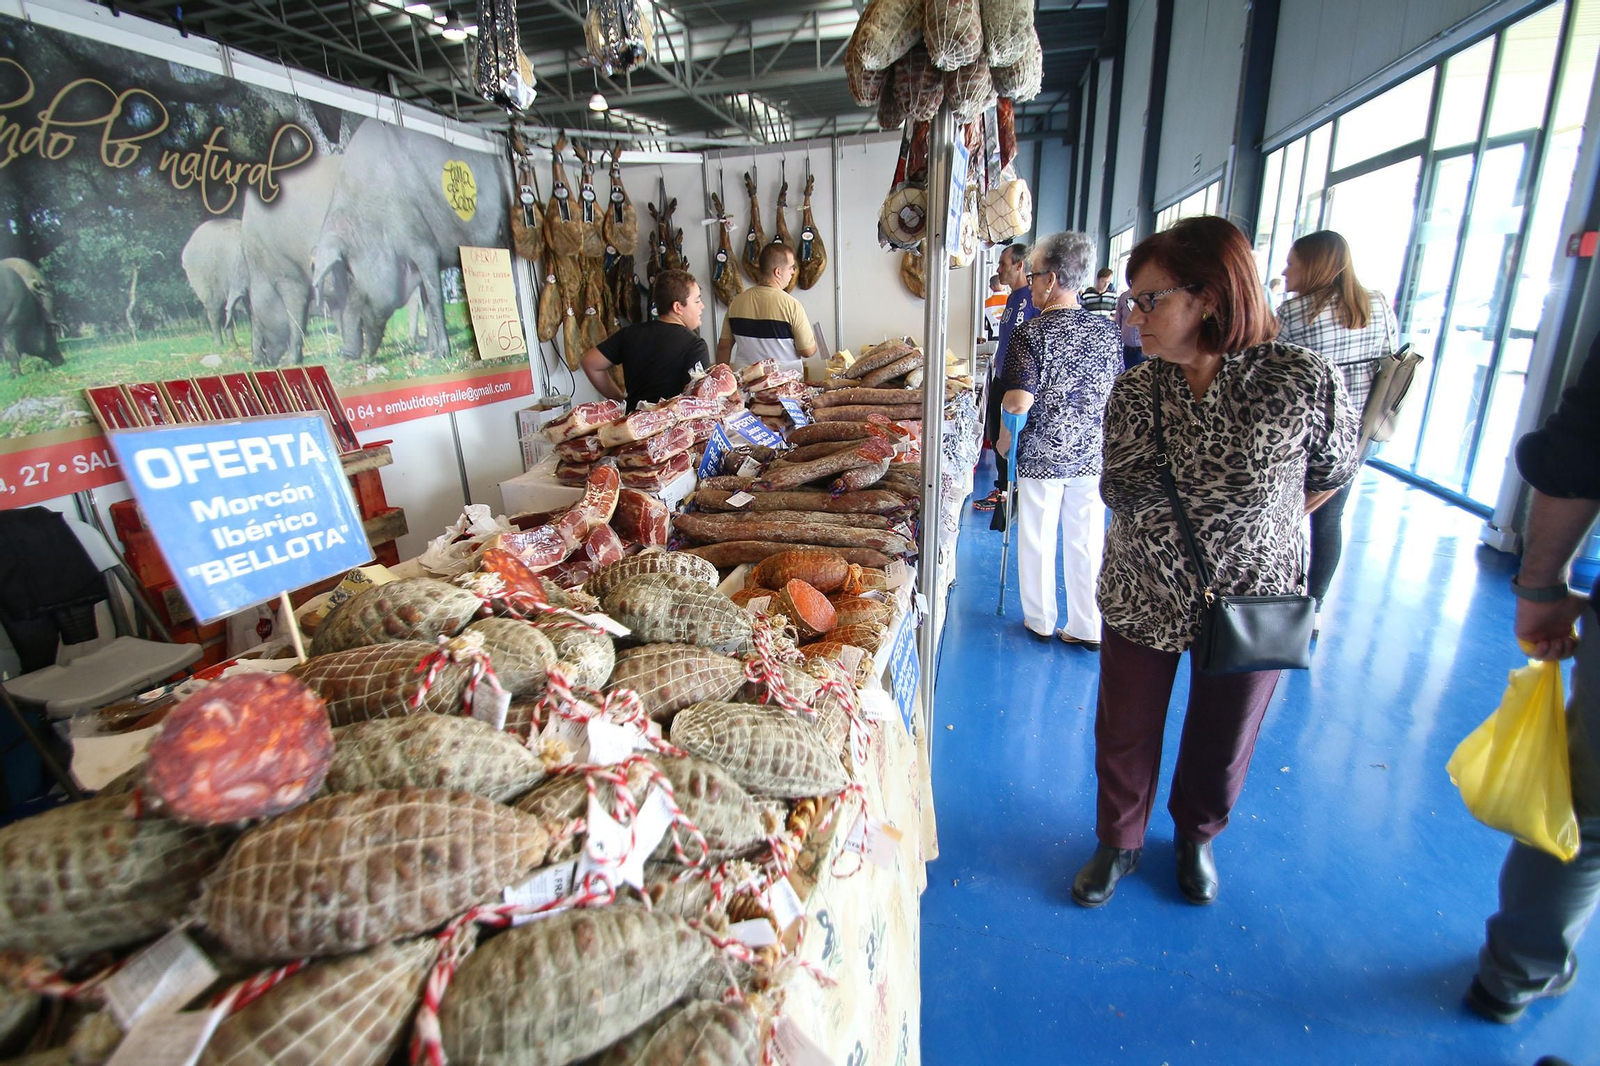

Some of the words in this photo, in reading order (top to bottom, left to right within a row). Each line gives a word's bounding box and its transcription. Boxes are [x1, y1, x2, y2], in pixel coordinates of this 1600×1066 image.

[159, 123, 313, 214] natural
[358, 403, 375, 419] 64
[385, 382, 511, 415] embutidosjfraile@gmail.com
[20, 461, 50, 487] 27
[134, 431, 327, 489] OFERTA
[189, 482, 314, 523] Morcón
[211, 511, 318, 550] Ibérico
[186, 524, 349, 587] "BELLOTA"
